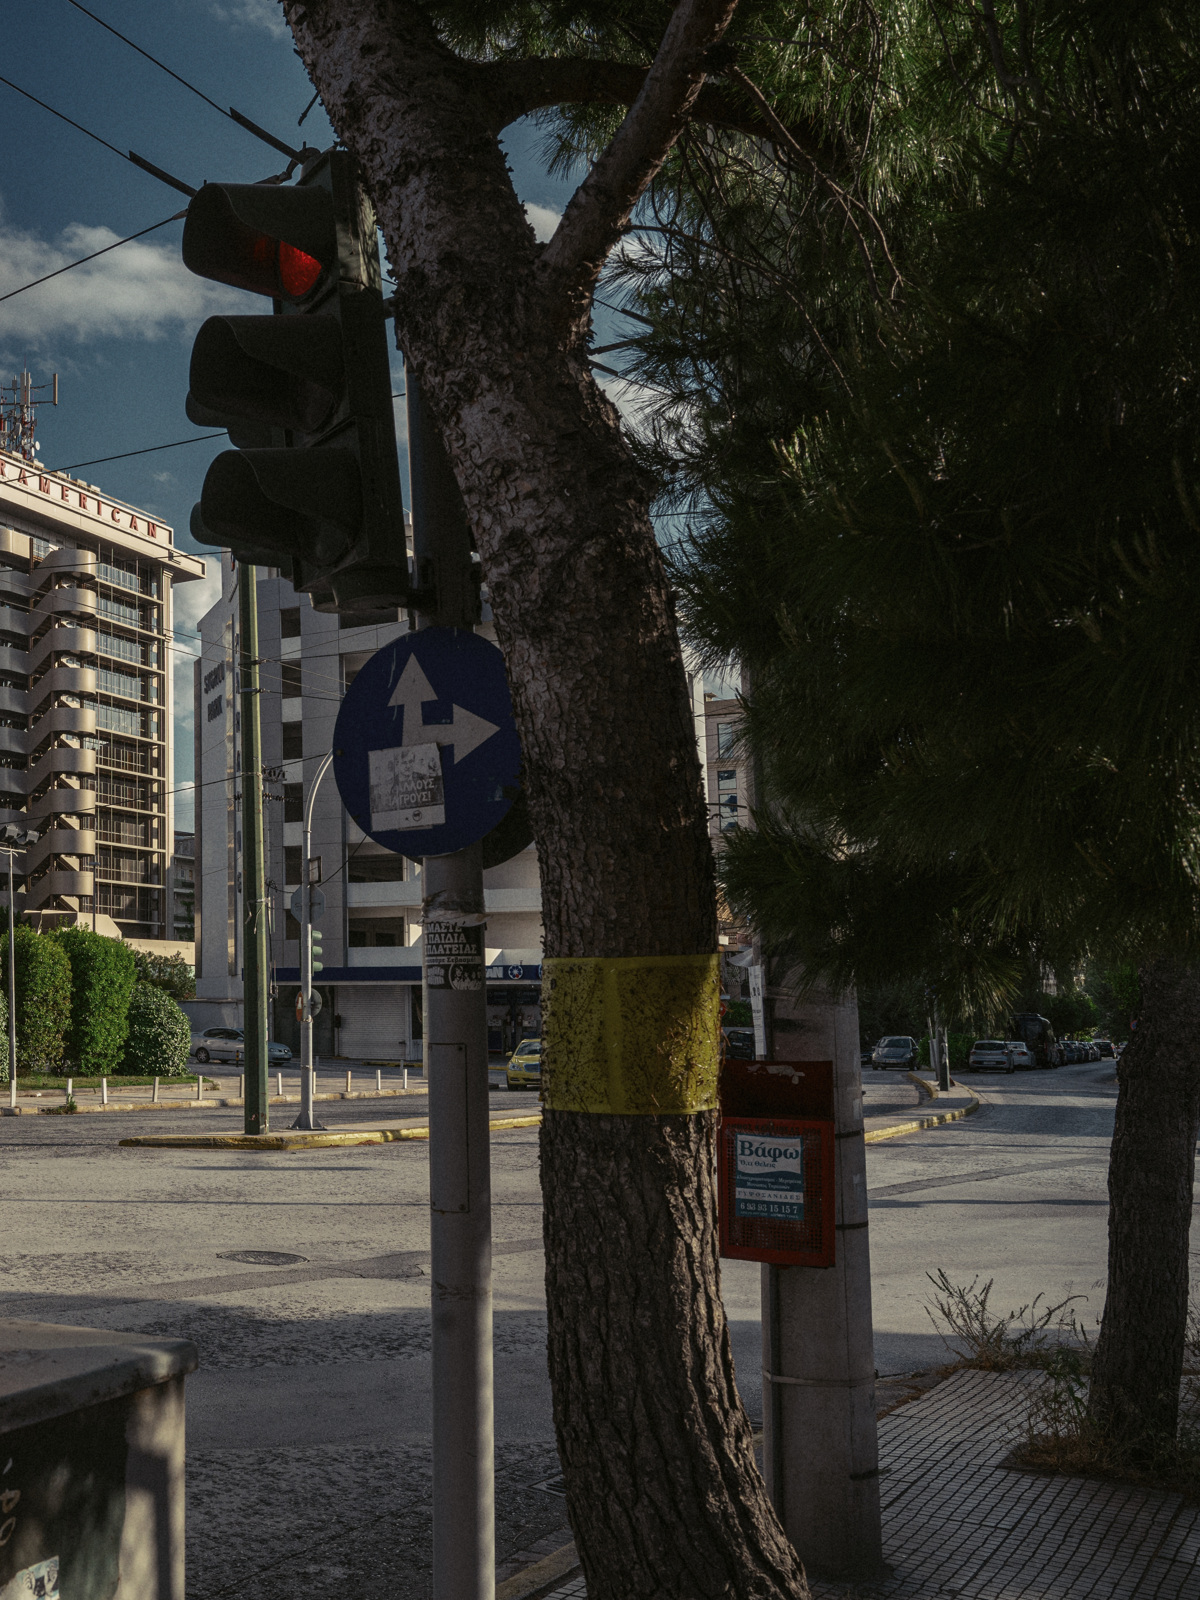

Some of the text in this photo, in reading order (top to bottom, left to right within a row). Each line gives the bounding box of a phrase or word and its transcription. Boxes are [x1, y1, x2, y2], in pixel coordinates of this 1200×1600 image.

[426, 922, 462, 933] ΜΑΣΤΕ
[739, 1139, 800, 1162] Βάφω
[740, 1202, 745, 1210] 6
[757, 1203, 767, 1212] 93
[769, 1204, 779, 1213] 15
[781, 1205, 791, 1214] 15
[792, 1206, 798, 1214] 7
